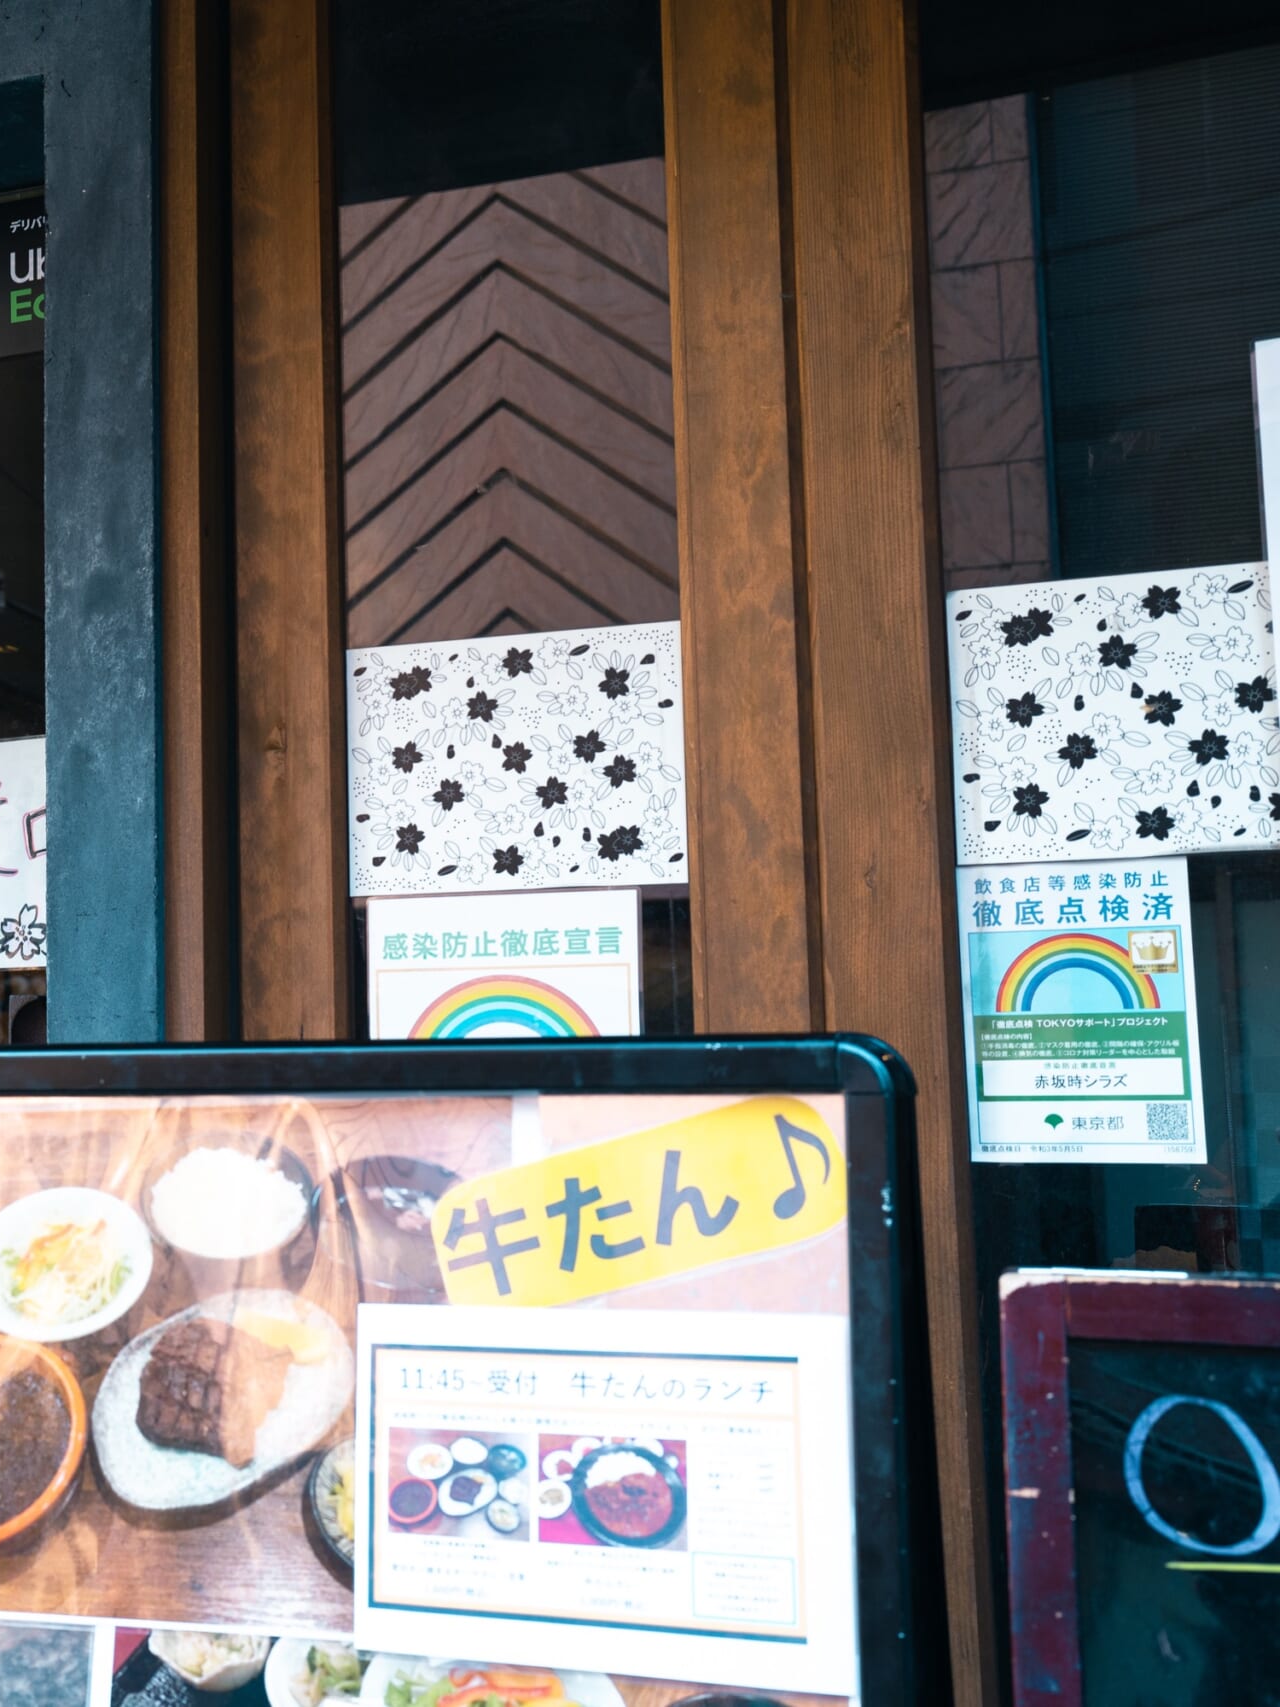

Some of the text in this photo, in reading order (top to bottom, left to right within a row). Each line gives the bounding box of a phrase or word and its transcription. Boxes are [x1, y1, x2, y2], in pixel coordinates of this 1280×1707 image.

[974, 871, 1169, 895] 飲食店等感染防止
[972, 892, 1174, 928] 徹底点検済
[382, 926, 623, 961] 感染防止徹底宣言
[1035, 1073, 1128, 1089] 赤坂時シラズ
[1072, 1115, 1125, 1131] 東京都
[442, 1150, 740, 1296] 牛たん
[570, 1371, 774, 1404] 牛たんのランチ
